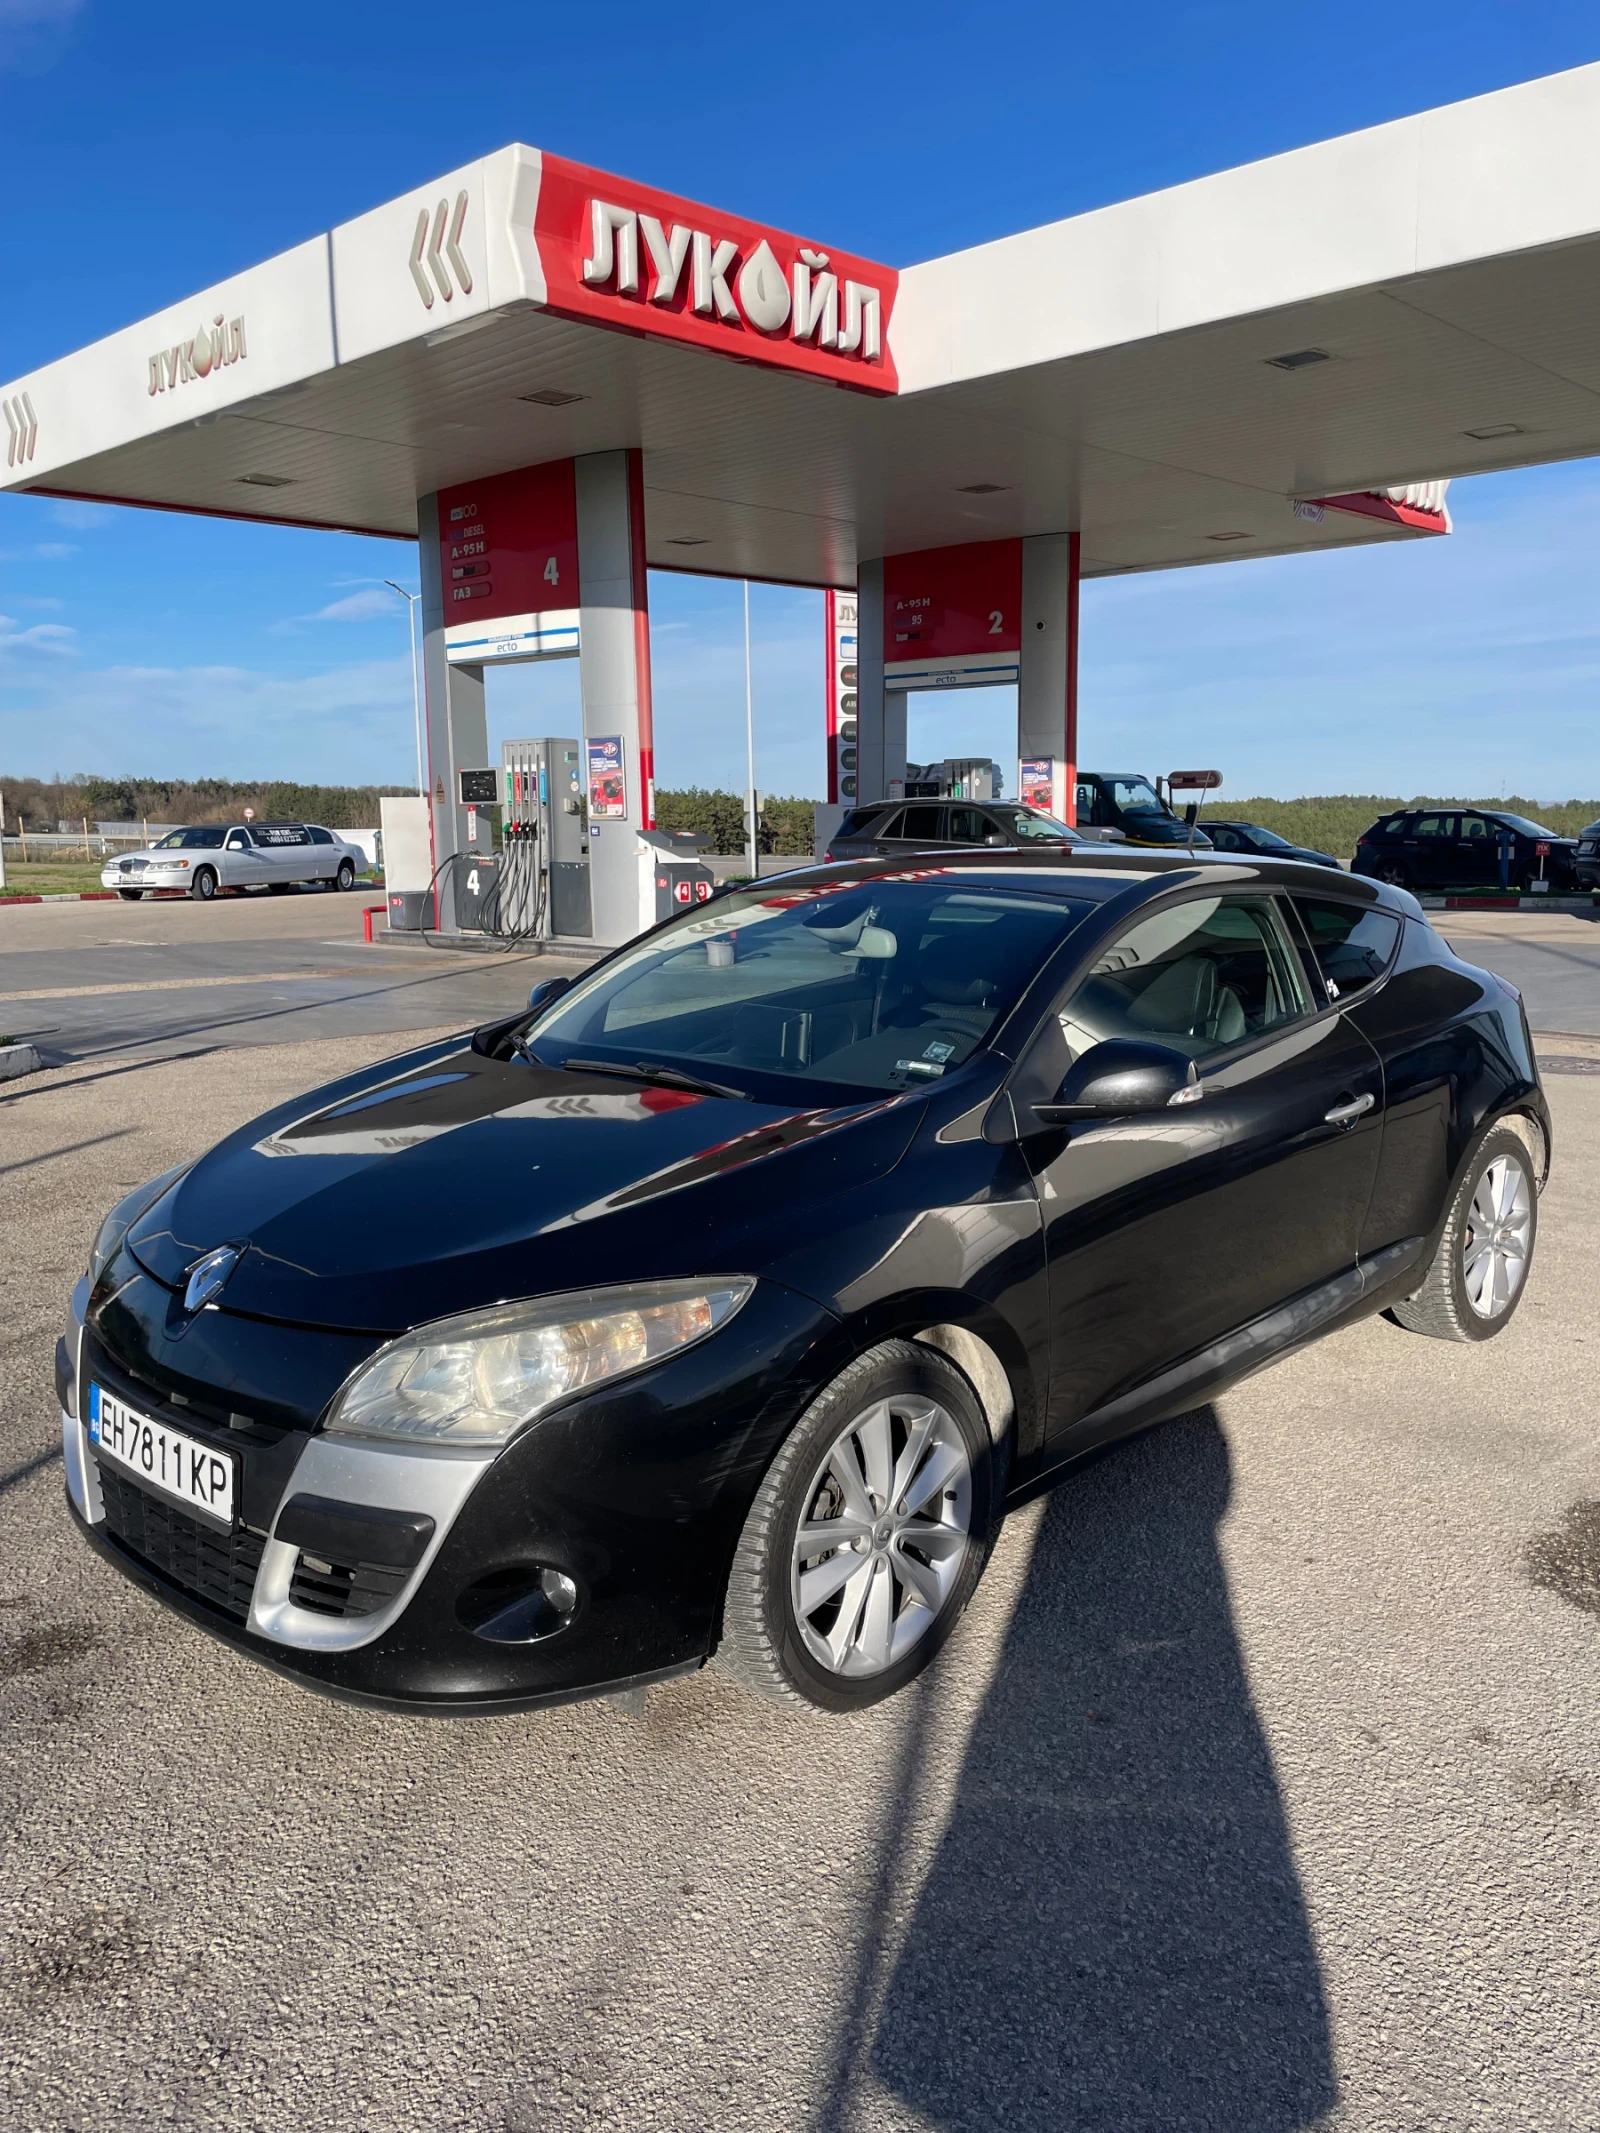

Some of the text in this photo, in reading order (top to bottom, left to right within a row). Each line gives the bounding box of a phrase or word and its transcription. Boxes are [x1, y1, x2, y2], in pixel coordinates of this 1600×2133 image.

[583, 199, 880, 358] ЛУКОЙЛ
[148, 314, 247, 396] ЛУКОЙЛ
[464, 524, 485, 538] DIESEL
[543, 557, 559, 586] 4
[453, 587, 471, 600] ГАЗ
[911, 614, 923, 625] 95
[988, 610, 1003, 634] 2
[497, 642, 518, 653] ecto
[935, 675, 957, 684] ecto
[604, 744, 617, 755] STP
[467, 869, 480, 895] 4
[681, 888, 688, 897] 4
[698, 888, 705, 897] 3
